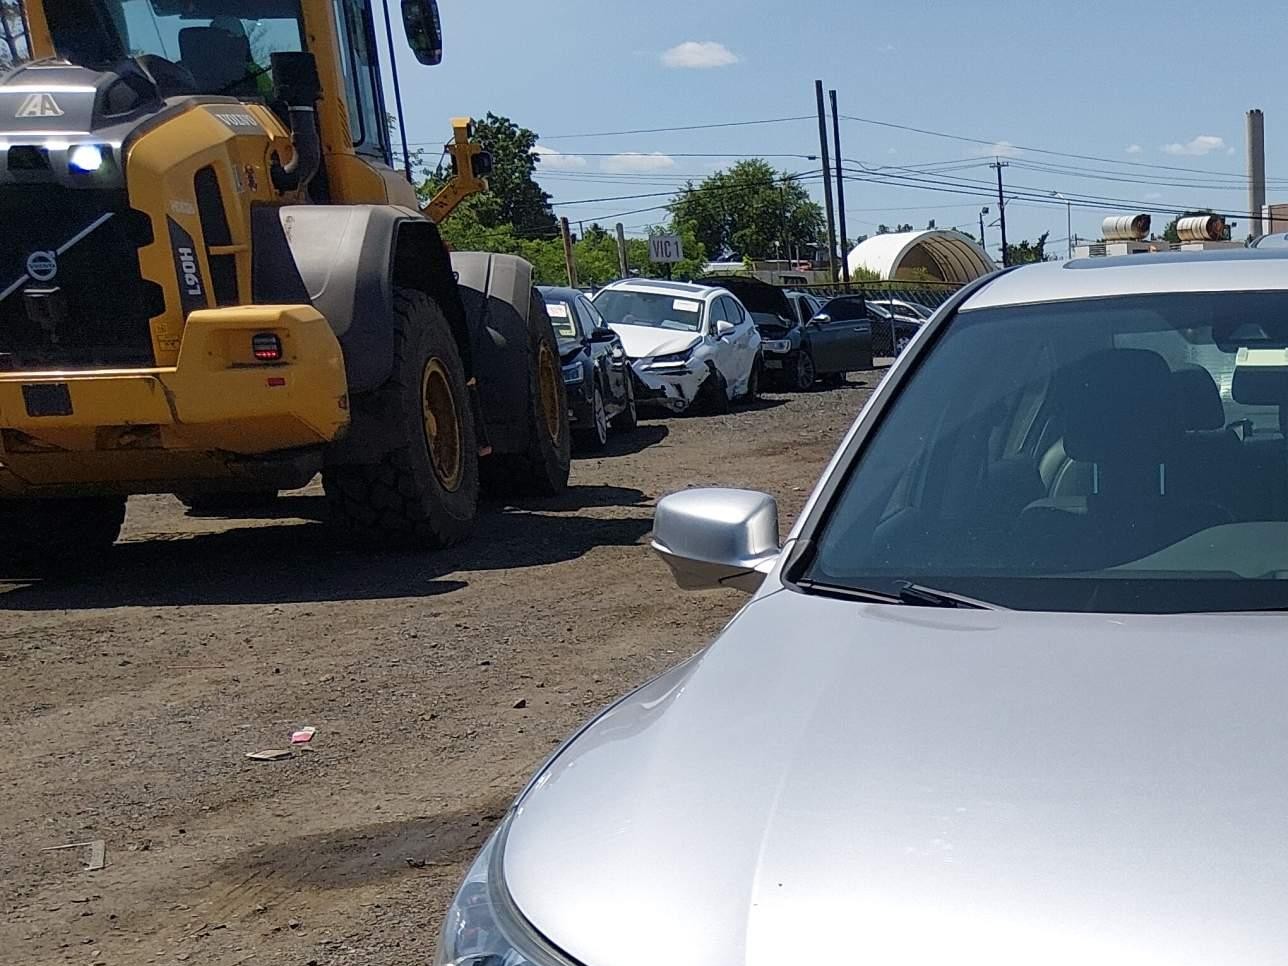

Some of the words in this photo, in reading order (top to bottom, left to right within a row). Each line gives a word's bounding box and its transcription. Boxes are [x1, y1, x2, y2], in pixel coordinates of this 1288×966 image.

[653, 240, 671, 257] VIC
[674, 241, 680, 258] 1
[179, 247, 201, 295] L90H
